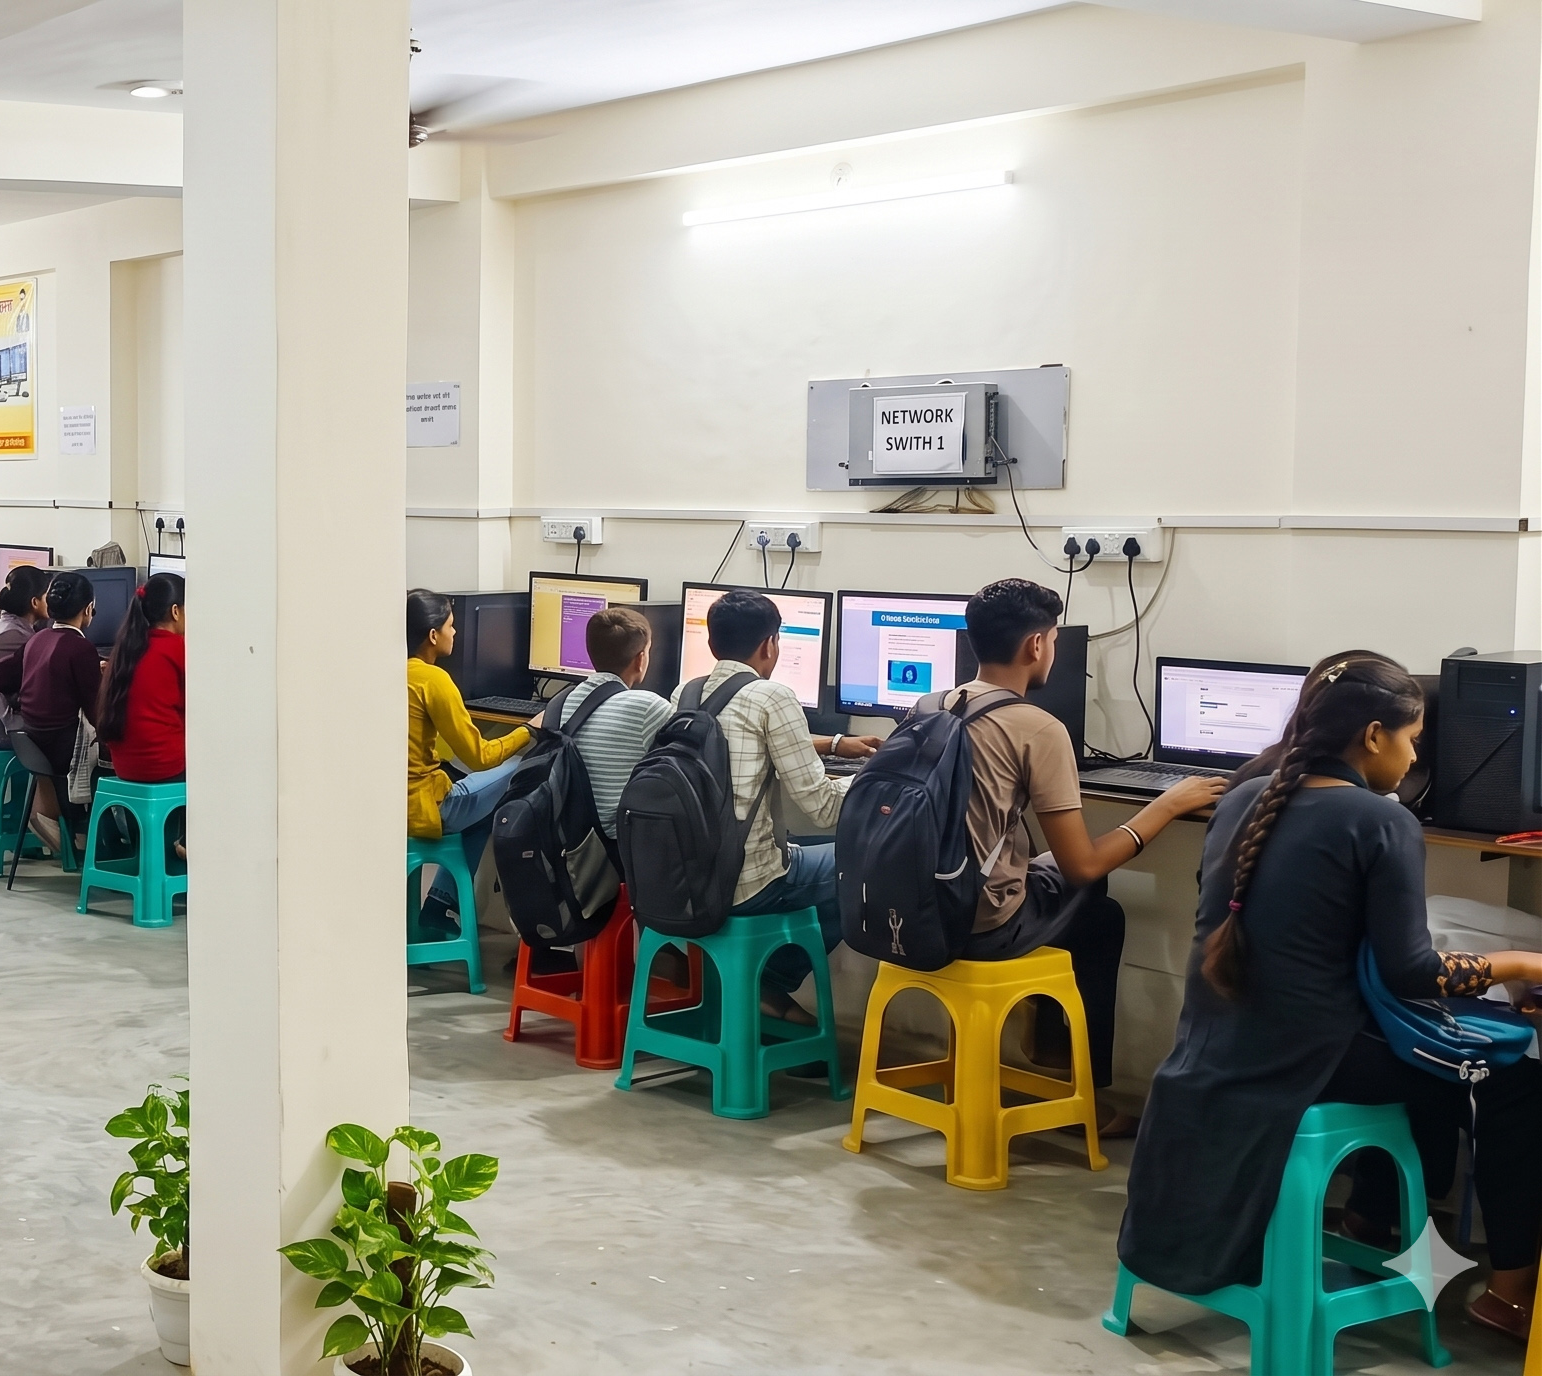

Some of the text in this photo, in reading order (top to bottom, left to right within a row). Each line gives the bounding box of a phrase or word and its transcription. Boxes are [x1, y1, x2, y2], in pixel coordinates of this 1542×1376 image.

[881, 408, 954, 425] NETWORK
[885, 436, 944, 451] SWITH 1
